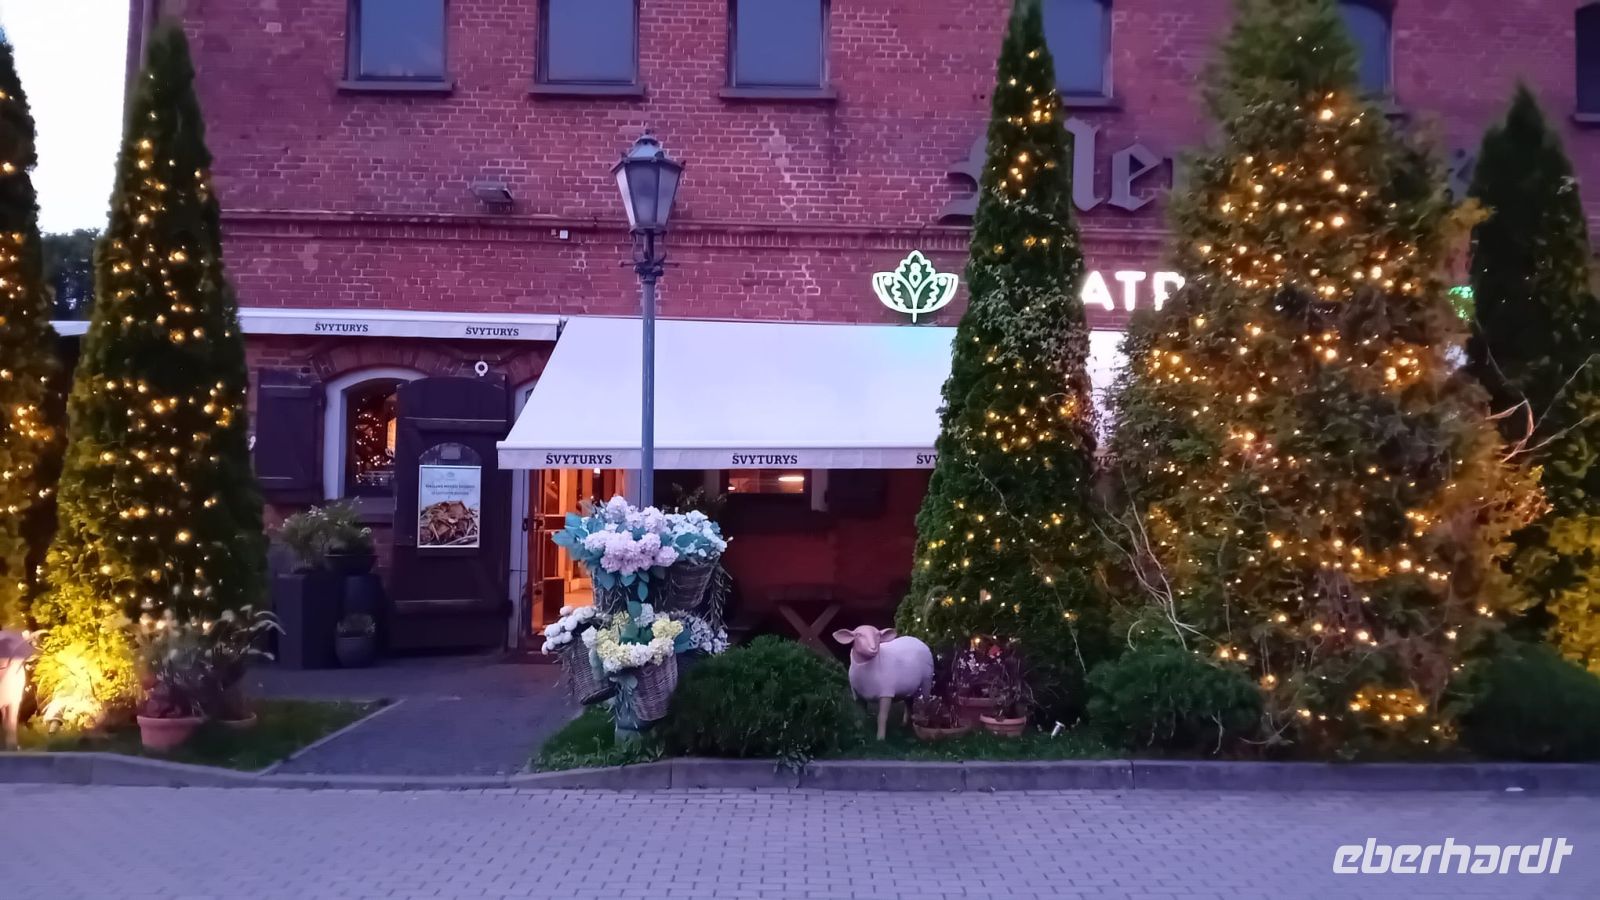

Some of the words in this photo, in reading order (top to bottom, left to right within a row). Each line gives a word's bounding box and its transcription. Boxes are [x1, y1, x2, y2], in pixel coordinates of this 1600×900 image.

[315, 322, 369, 333] ŠVYTURYS
[465, 325, 519, 337] ŠVYTURYS
[546, 452, 612, 465] ŠVYTURYS
[732, 452, 798, 465] ŠVYTURYS
